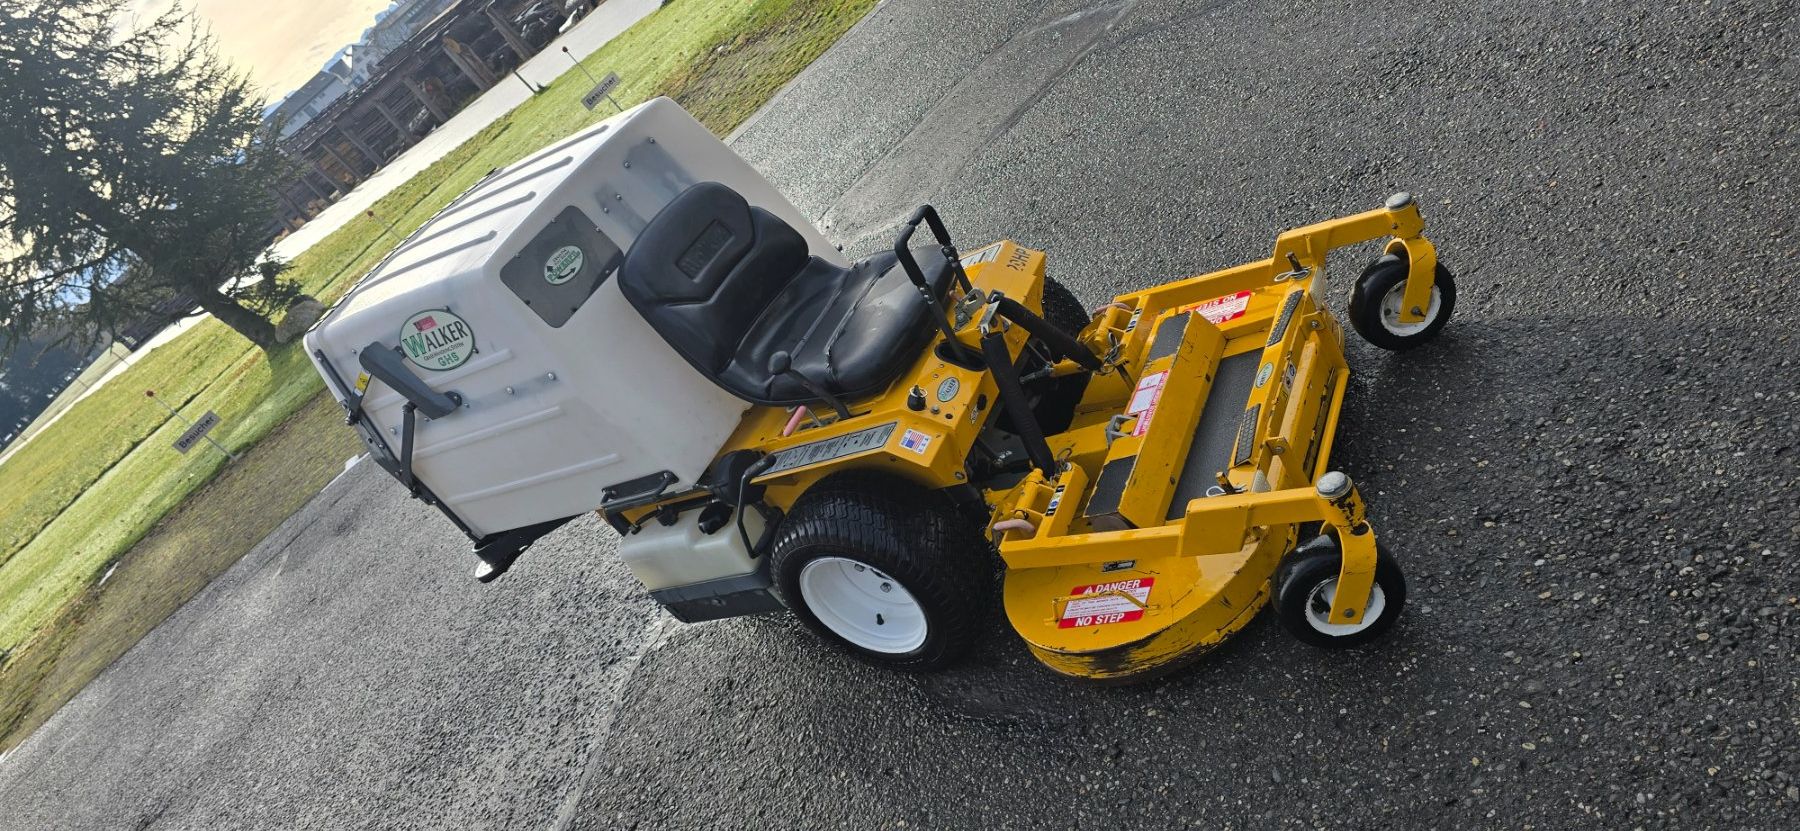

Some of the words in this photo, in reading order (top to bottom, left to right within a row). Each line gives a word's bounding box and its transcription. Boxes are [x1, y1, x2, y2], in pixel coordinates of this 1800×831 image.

[402, 320, 468, 358] WALKER
[437, 352, 459, 366] GHS
[178, 415, 215, 449] Besucher
[1095, 579, 1141, 592] DANGER
[1075, 616, 1092, 627] NO
[1095, 613, 1125, 625] STEP
